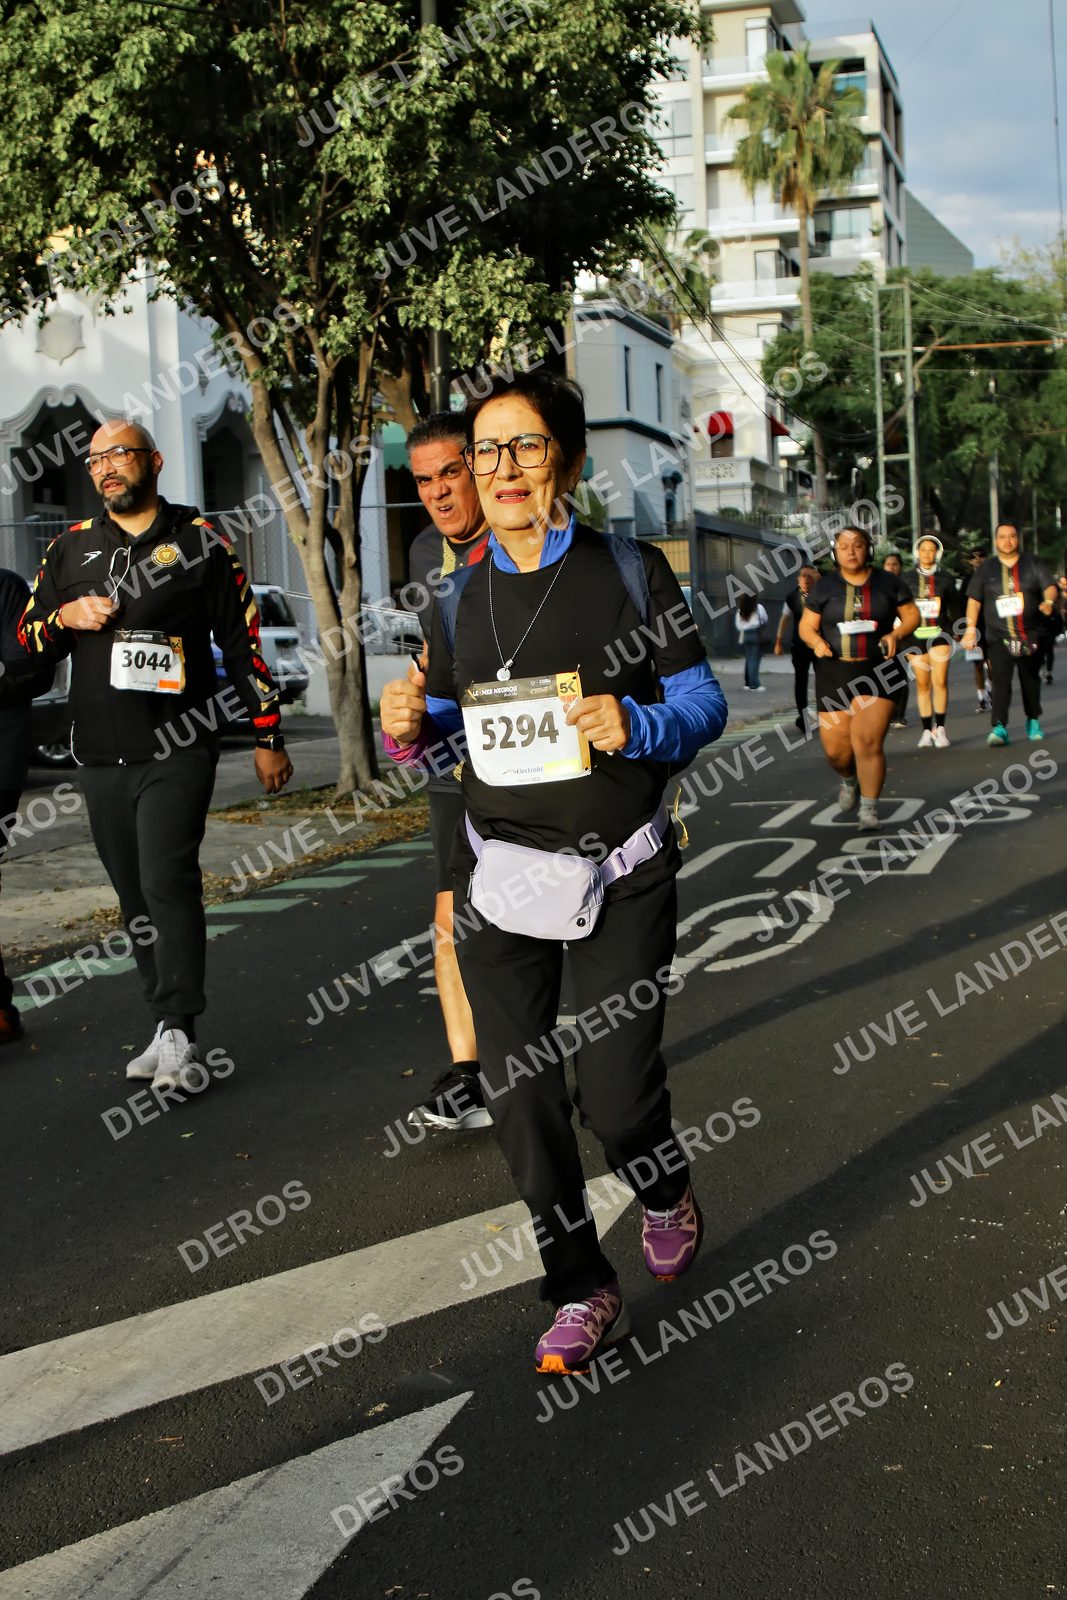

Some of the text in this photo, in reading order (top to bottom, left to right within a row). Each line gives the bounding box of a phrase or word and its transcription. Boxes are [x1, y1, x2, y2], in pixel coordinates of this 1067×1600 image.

[122, 649, 171, 672] 3044
[560, 681, 576, 694] 5K
[481, 711, 559, 751] 5294
